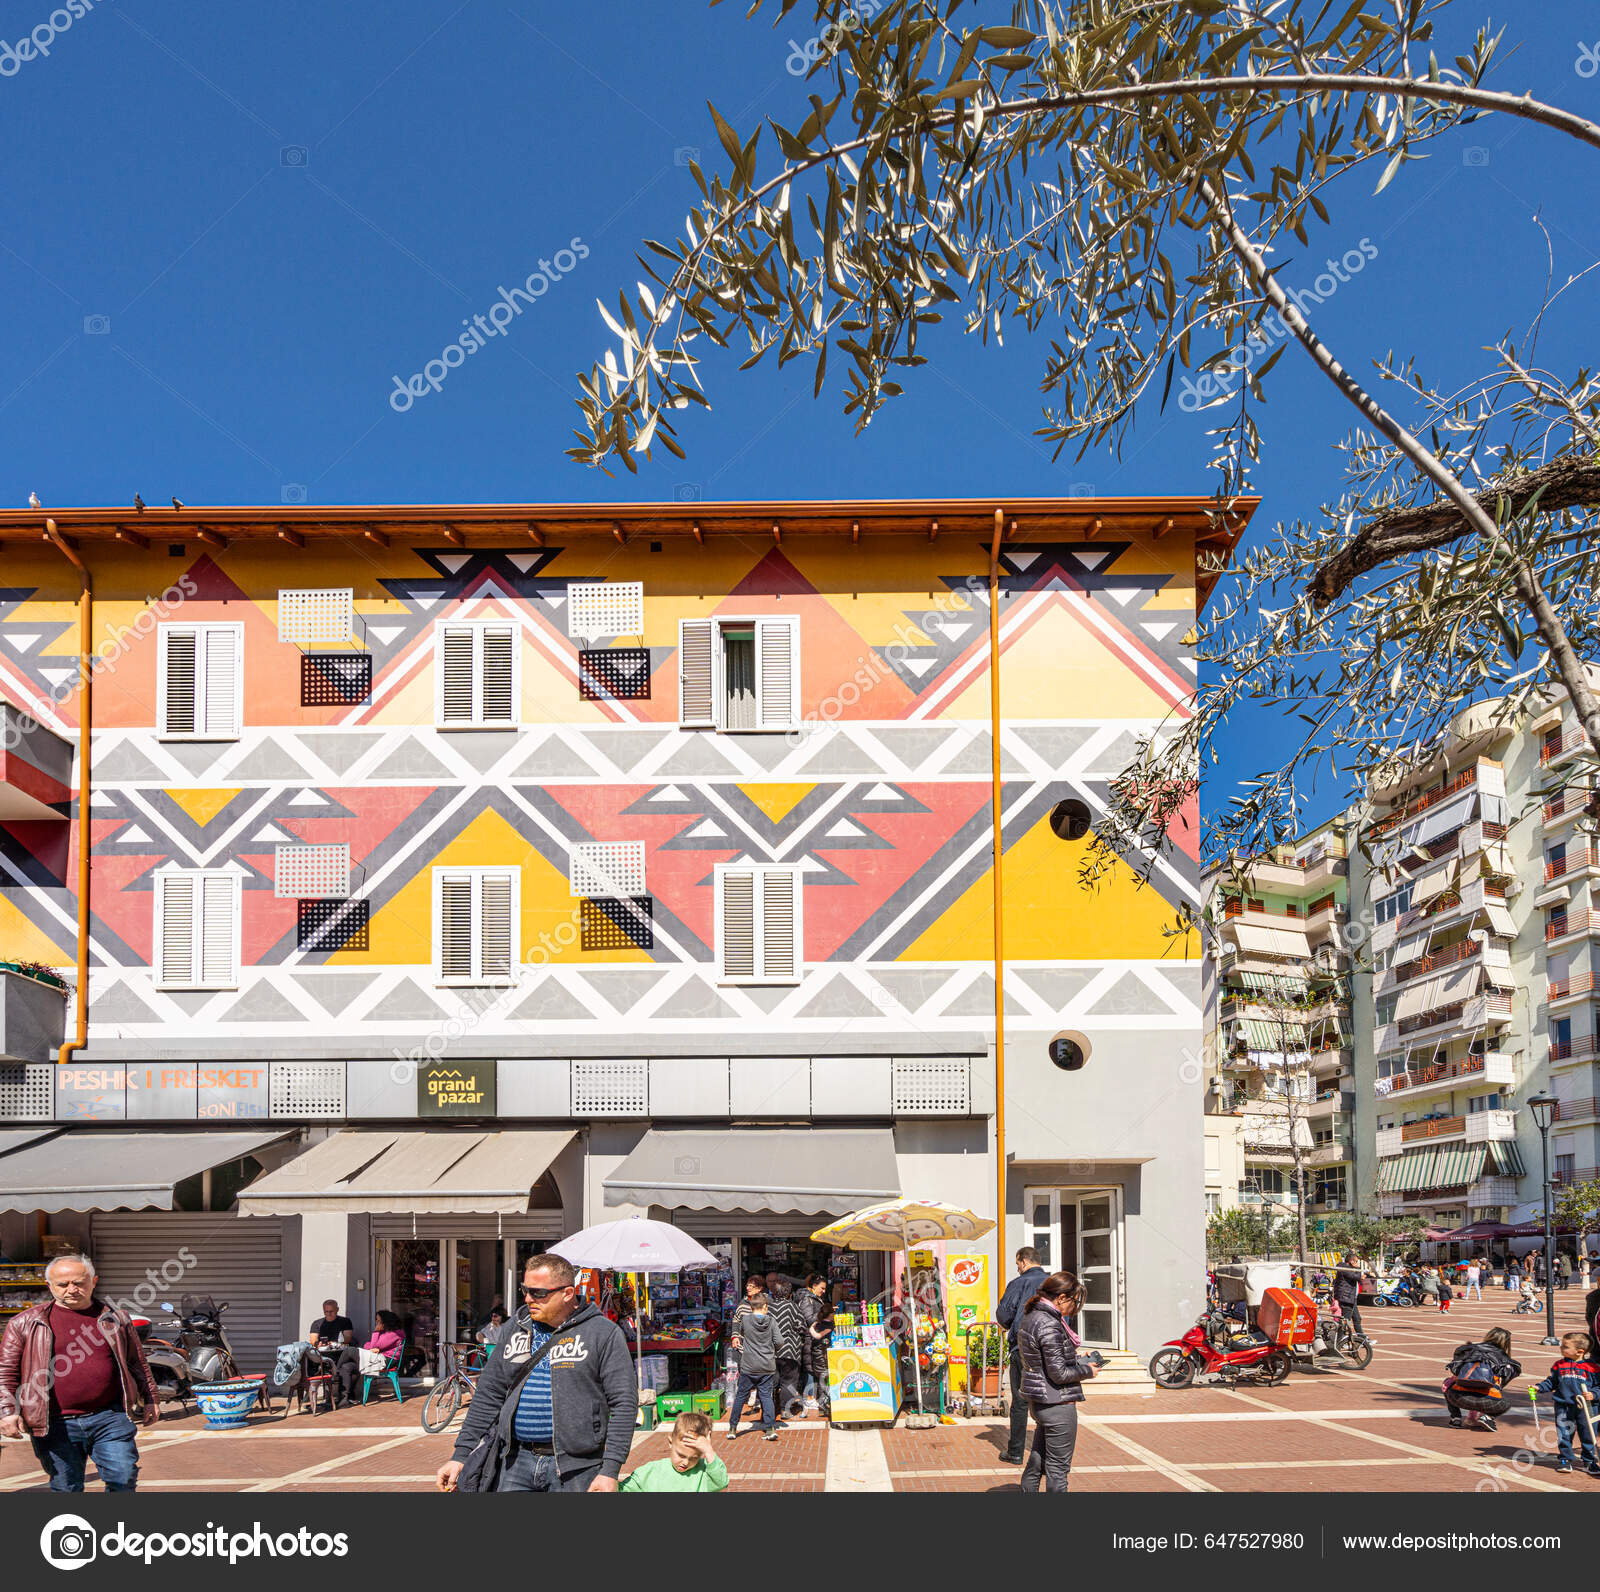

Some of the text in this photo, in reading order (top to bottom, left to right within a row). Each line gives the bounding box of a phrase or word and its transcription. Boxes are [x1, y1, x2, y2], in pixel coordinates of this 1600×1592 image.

[58, 1070, 265, 1090] PESHK I FRESKET
[428, 1076, 476, 1095] grand
[438, 1092, 485, 1108] pazar
